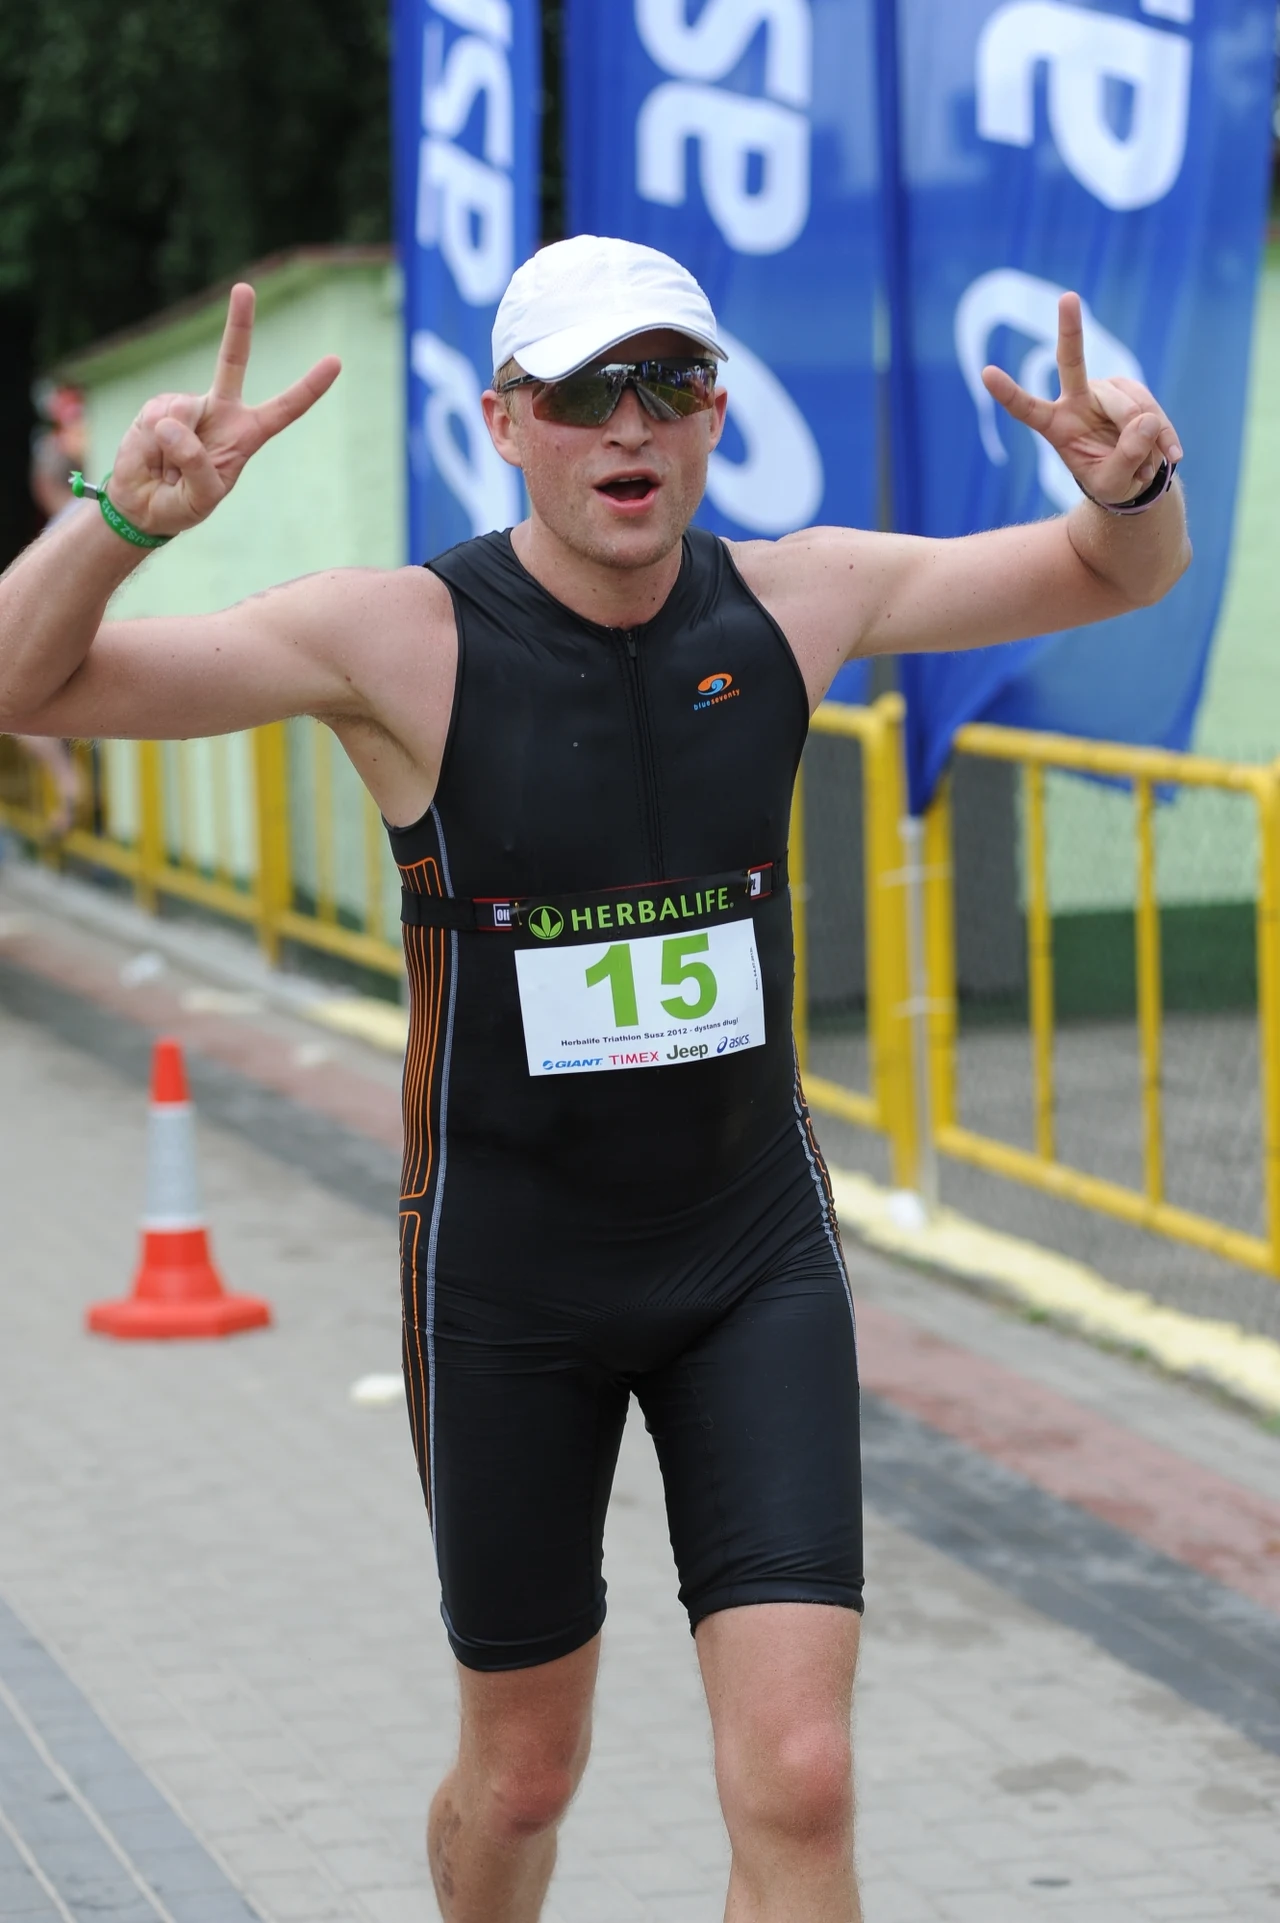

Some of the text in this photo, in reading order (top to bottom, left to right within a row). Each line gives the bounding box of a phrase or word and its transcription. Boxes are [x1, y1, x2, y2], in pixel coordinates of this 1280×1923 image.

[101, 498, 122, 526] 2012
[693, 689, 740, 710] blueseventy
[571, 887, 729, 931] HERBALIFE
[585, 932, 718, 1028] 15
[561, 1038, 600, 1046] Herbalife
[602, 1034, 641, 1043] Triathlon
[667, 1028, 688, 1037] 2012
[694, 1022, 721, 1033] dystans
[555, 1058, 603, 1068] GIANT
[608, 1051, 659, 1065] TIMEX
[666, 1043, 708, 1059] Jeep
